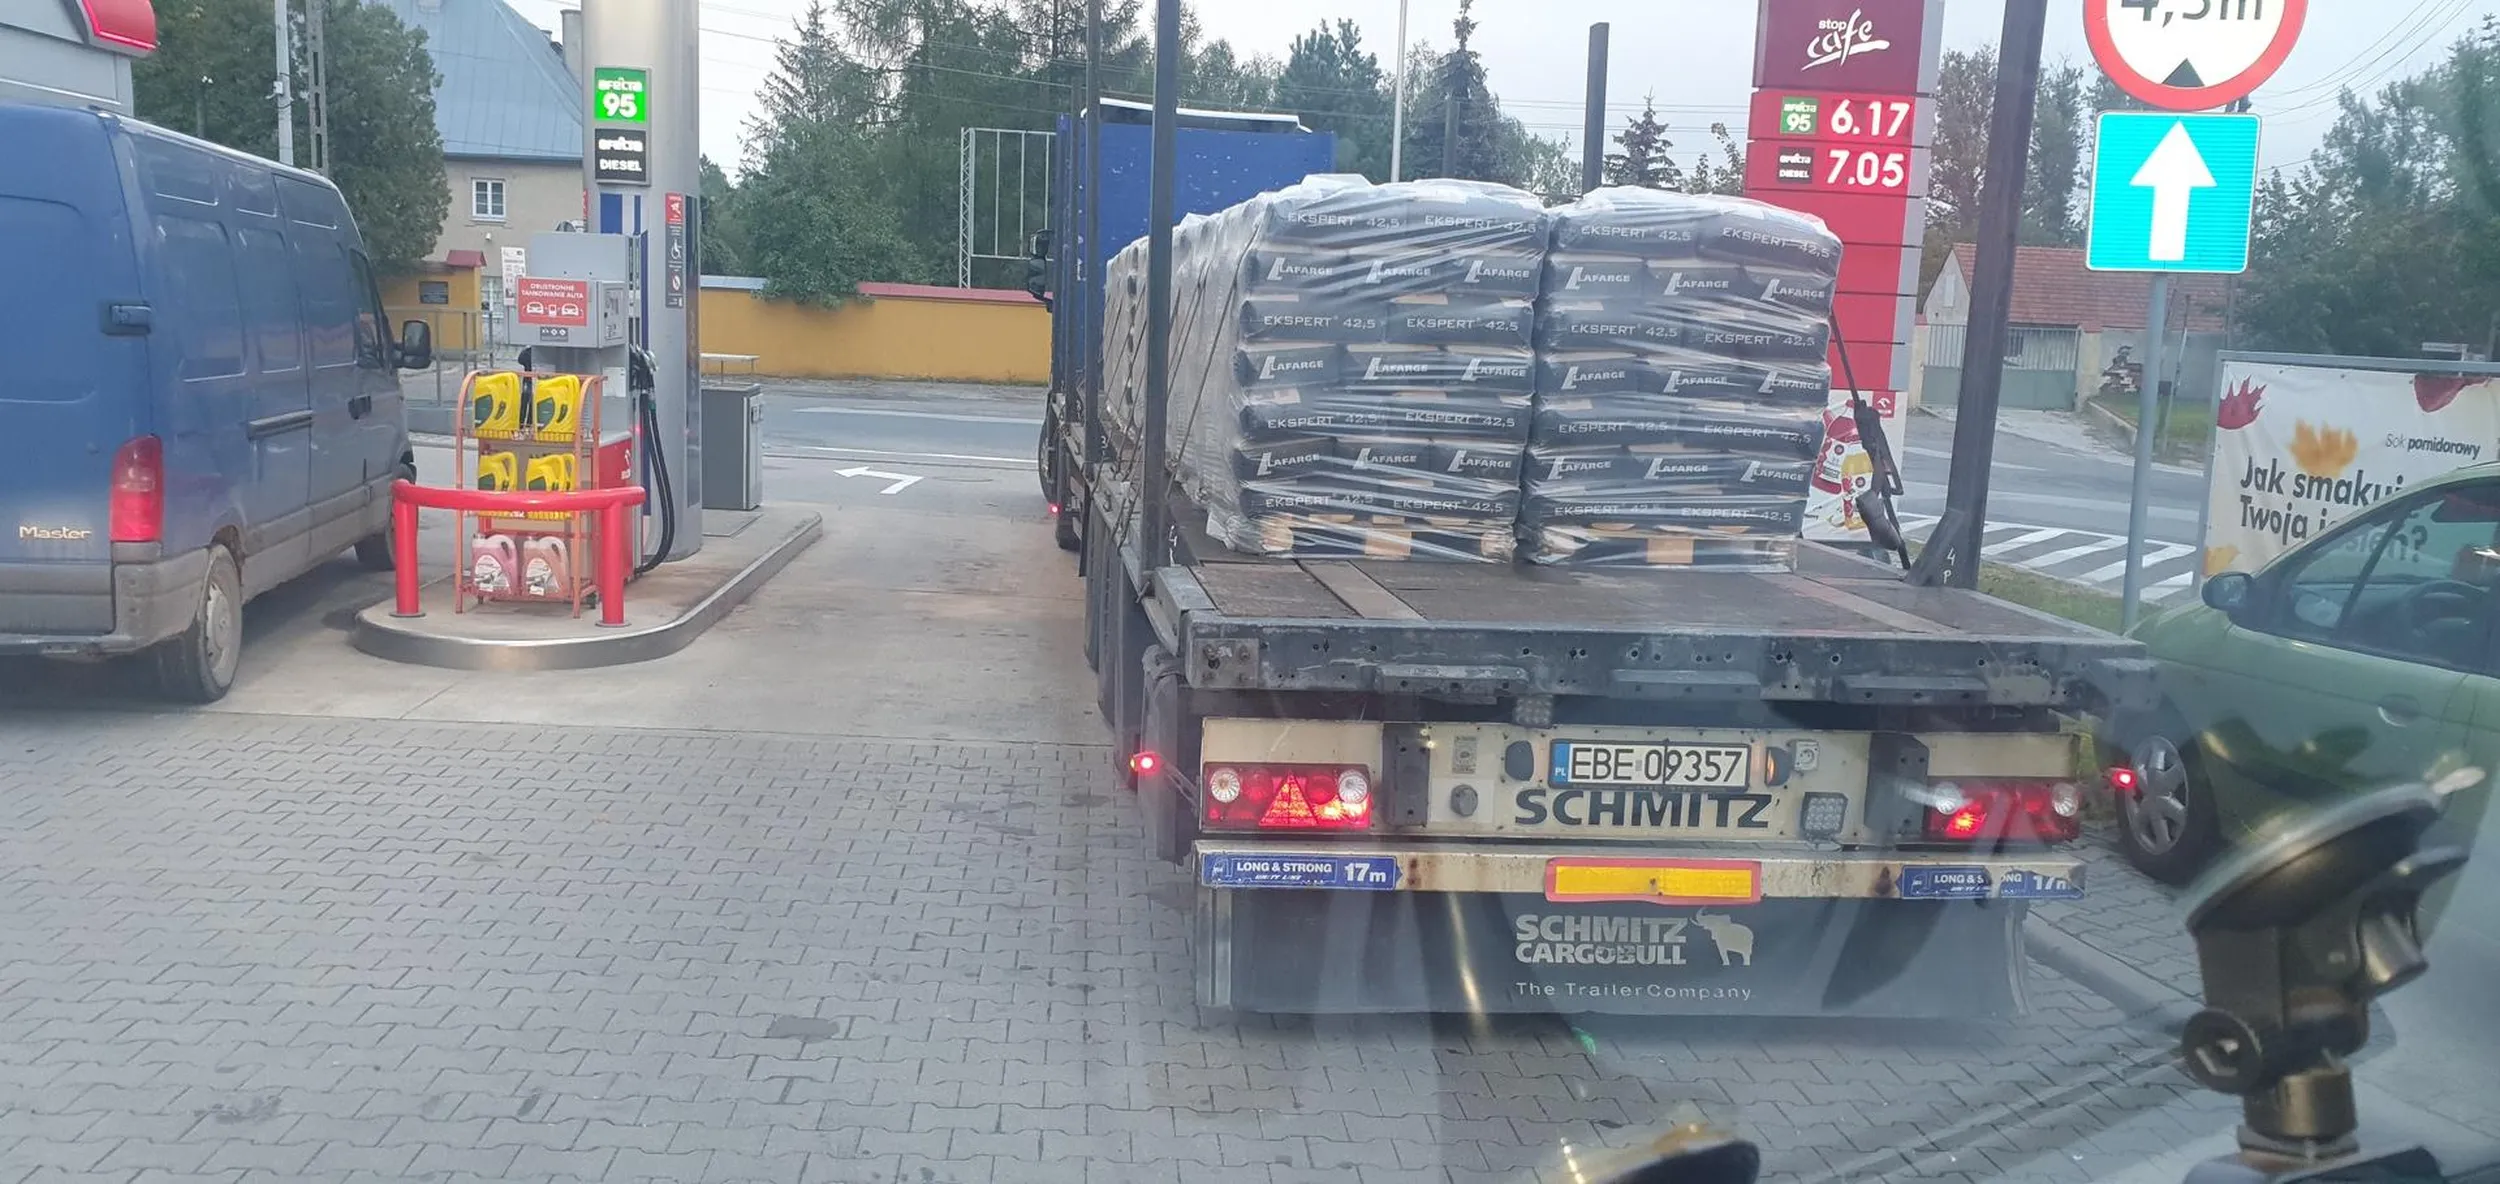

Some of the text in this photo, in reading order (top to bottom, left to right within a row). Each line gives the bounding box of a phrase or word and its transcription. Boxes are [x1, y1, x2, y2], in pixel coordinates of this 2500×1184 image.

[1819, 19, 1847, 31] stop
[603, 92, 637, 117] 95
[1786, 115, 1811, 131] 95
[1831, 99, 1910, 137] 6.17
[600, 159, 642, 172] DIESEL
[1779, 170, 1809, 178] DIESEL
[1827, 150, 1904, 187] 7.05
[1580, 225, 1648, 239] EKSPERT
[1267, 257, 1334, 281] LAFARGE
[1365, 260, 1431, 284] LAFARGE
[1464, 259, 1530, 284] LAFARGE
[1565, 266, 1631, 290] LAFARGE
[1663, 272, 1729, 296] LAFARGE
[1759, 279, 1826, 302] LAFARGE
[1263, 315, 1376, 330] EKSPERT 42,5
[1406, 317, 1519, 333] EKSPERT 42,5
[1645, 324, 1678, 338] 42,5
[1704, 332, 1772, 346] EKSPERT
[1259, 356, 1324, 380] LAFARGE
[1363, 357, 1428, 380] LAFARGE
[1461, 358, 1527, 381] LAFARGE
[1560, 366, 1626, 390] LAFARGE
[1663, 371, 1729, 393] LAFARGE
[1758, 371, 1822, 394] LAFARGE
[1267, 414, 1334, 430] EKSPERT
[1405, 412, 1474, 426] EKSPERT
[1352, 448, 1417, 470] LAFARGE
[2407, 436, 2480, 460] pomidorowy
[1257, 452, 1321, 476] LAFARGE
[1447, 450, 1512, 472] LAFARGE
[1547, 456, 1612, 480] LAFARGE
[1644, 458, 1709, 480] LAFARGE
[1740, 461, 1805, 483] LAFARGE
[2240, 456, 2284, 495] Jak
[2240, 494, 2308, 545] Twoja
[19, 526, 92, 539] Master
[1947, 547, 1956, 566] 4
[1555, 747, 1742, 782] PL EBE 09357
[1514, 789, 1773, 829] SCHMITZ
[1237, 862, 1386, 882] LONG & STRONG 17m
[1934, 875, 1965, 883] LONG
[1967, 875, 1975, 883] &
[1515, 914, 1690, 943] SCHMITZ
[1515, 943, 1687, 965] CARGOBULL
[1516, 982, 1556, 997] The
